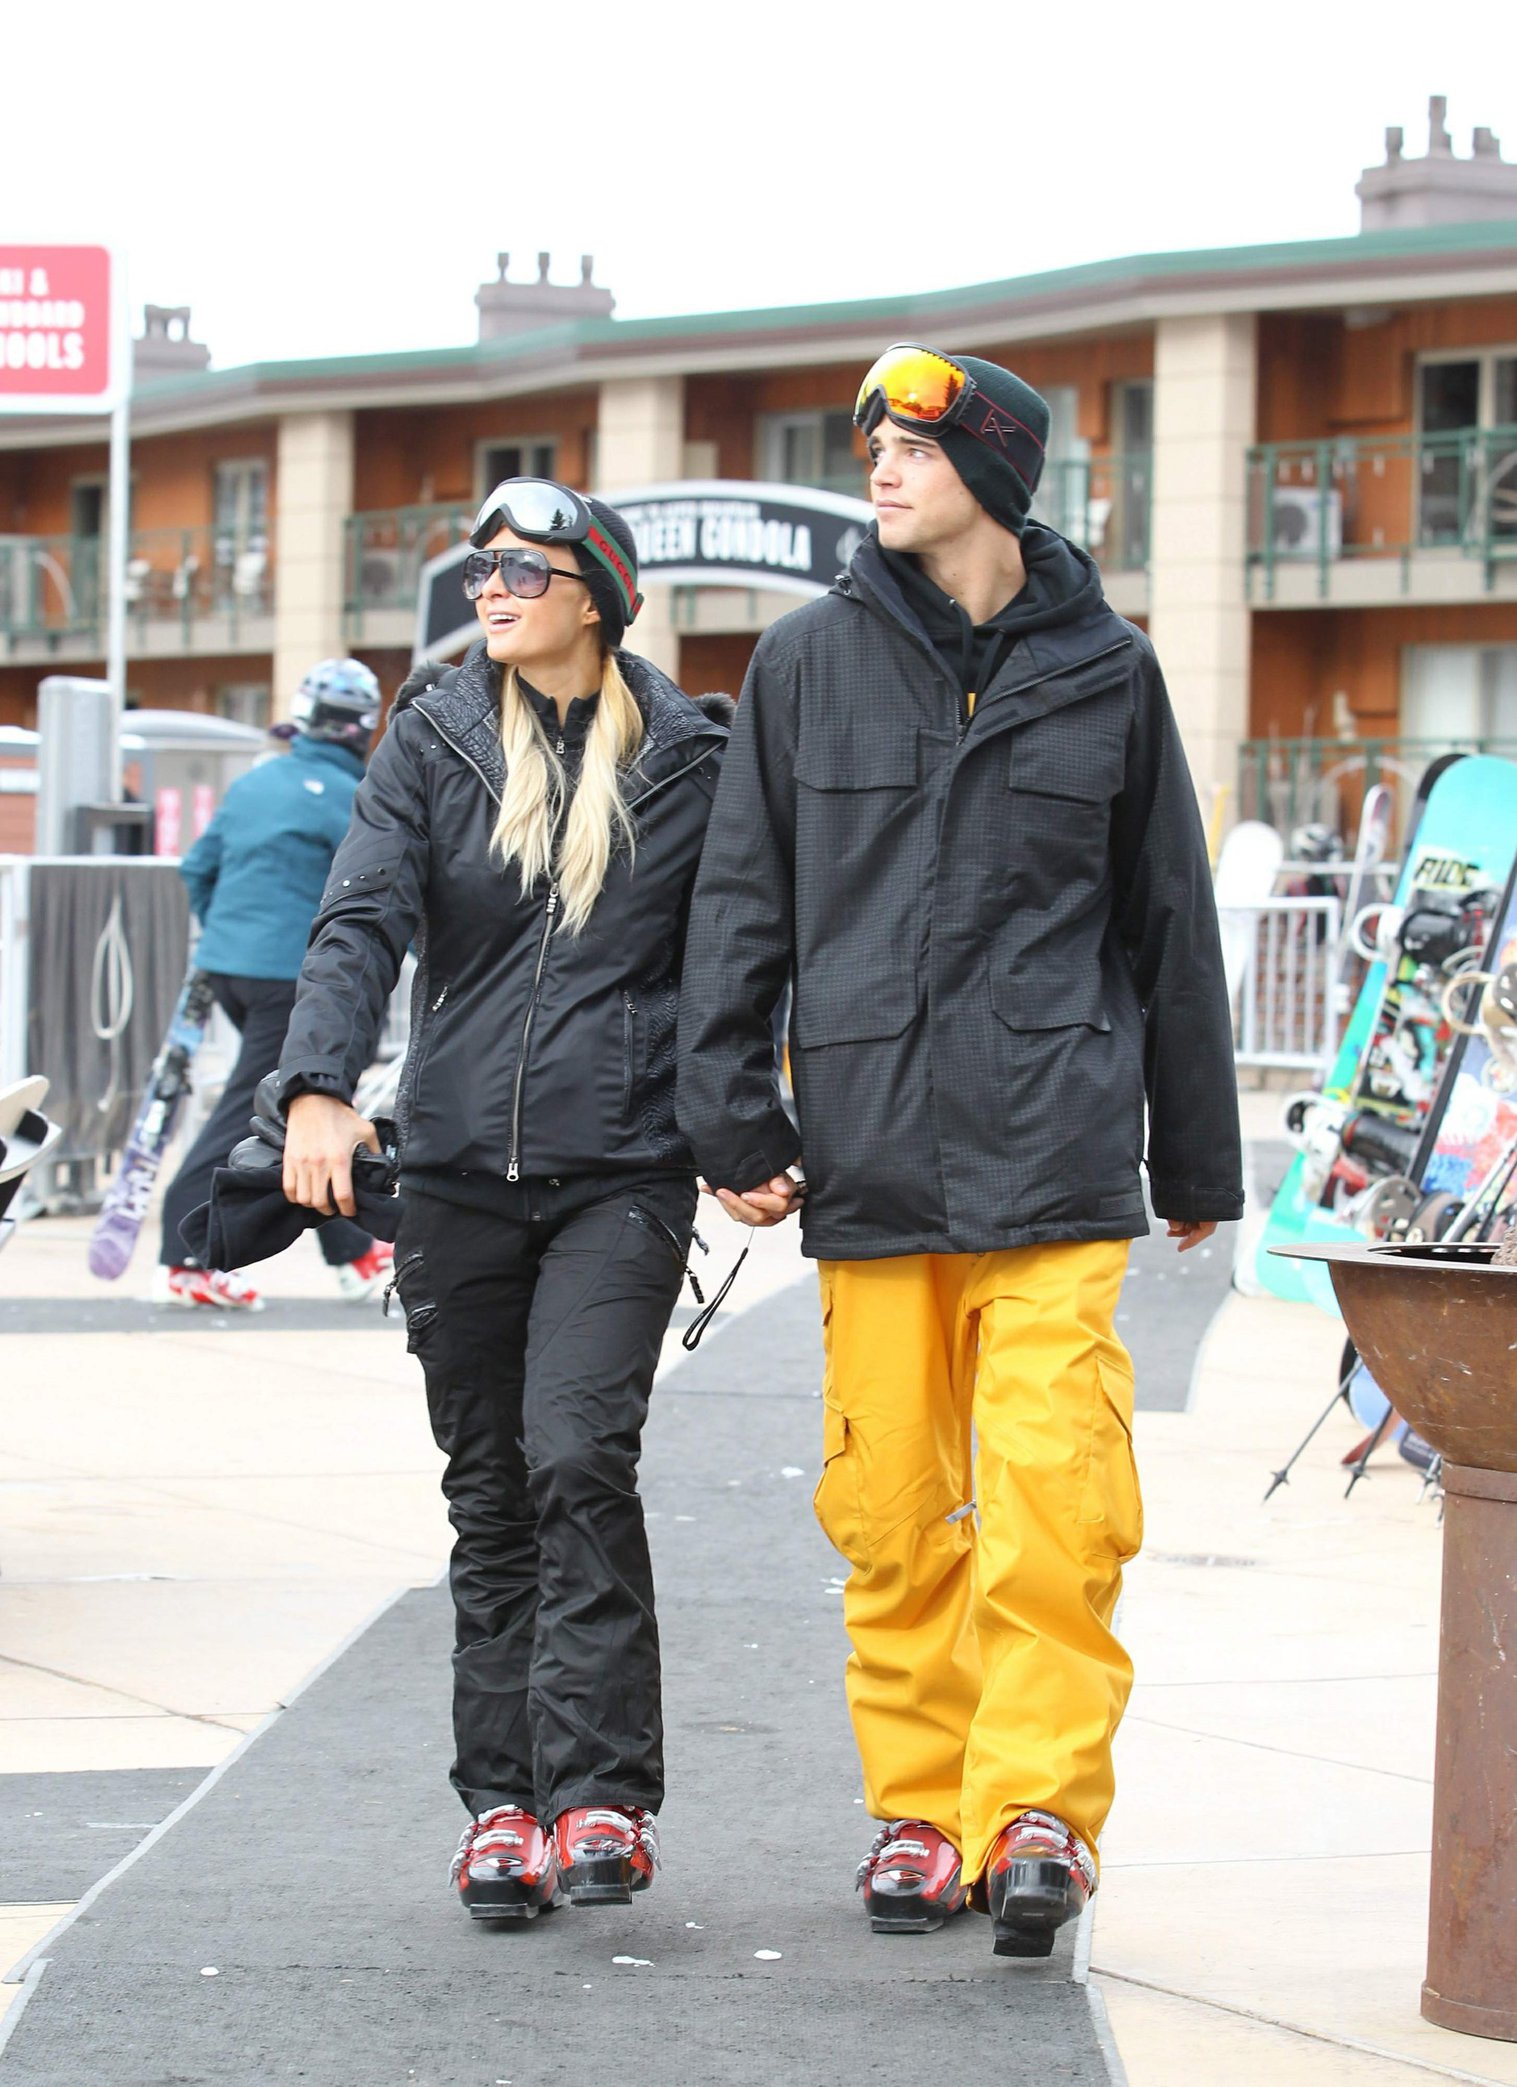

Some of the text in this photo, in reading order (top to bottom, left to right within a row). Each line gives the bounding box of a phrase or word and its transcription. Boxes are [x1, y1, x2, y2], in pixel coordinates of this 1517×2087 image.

[599, 540, 634, 589] GUCCI
[631, 515, 812, 571] UEEN GONDOLA
